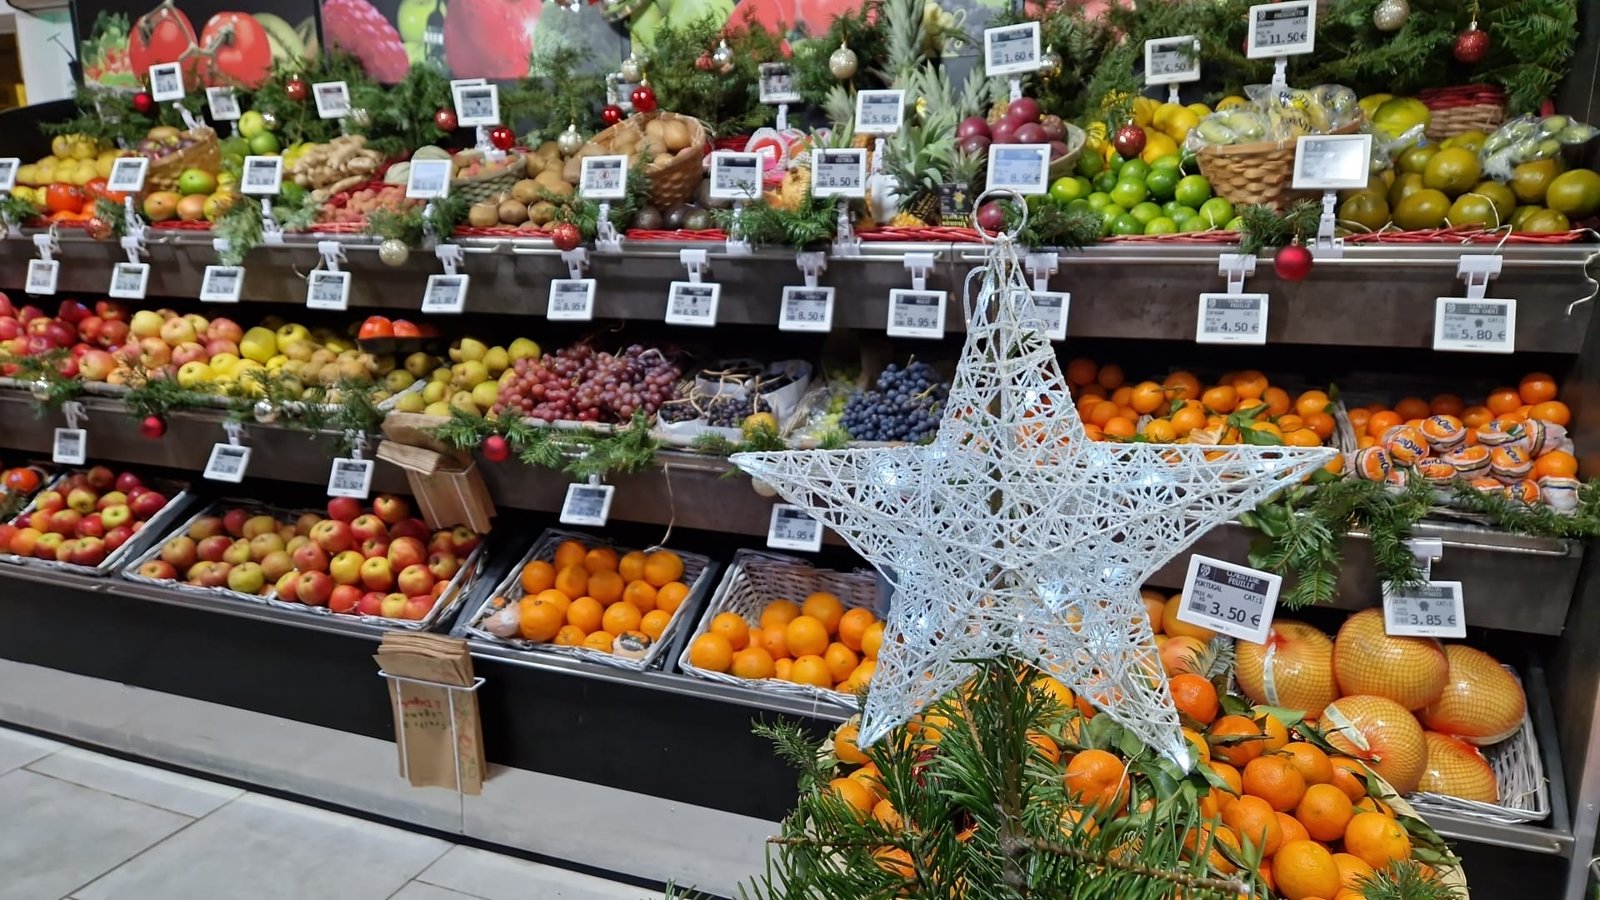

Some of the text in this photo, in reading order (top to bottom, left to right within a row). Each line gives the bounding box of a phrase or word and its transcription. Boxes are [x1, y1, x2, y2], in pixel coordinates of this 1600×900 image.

[1269, 32, 1300, 44] 11.50
[1004, 51, 1026, 63] 1.60
[872, 114, 891, 124] 5.95
[829, 177, 851, 187] 8.50
[907, 317, 929, 327] 8.95
[1221, 322, 1249, 332] 4.50
[1461, 328, 1493, 340] 5.80
[787, 529, 807, 540] 1.95
[1195, 580, 1222, 592] PORTUGAL
[1228, 577, 1255, 590] FEUILLE
[1243, 593, 1263, 605] CAT:1
[1210, 601, 1247, 623] 3.50
[1250, 614, 1261, 627] €
[1410, 613, 1457, 626] 3.85 €
